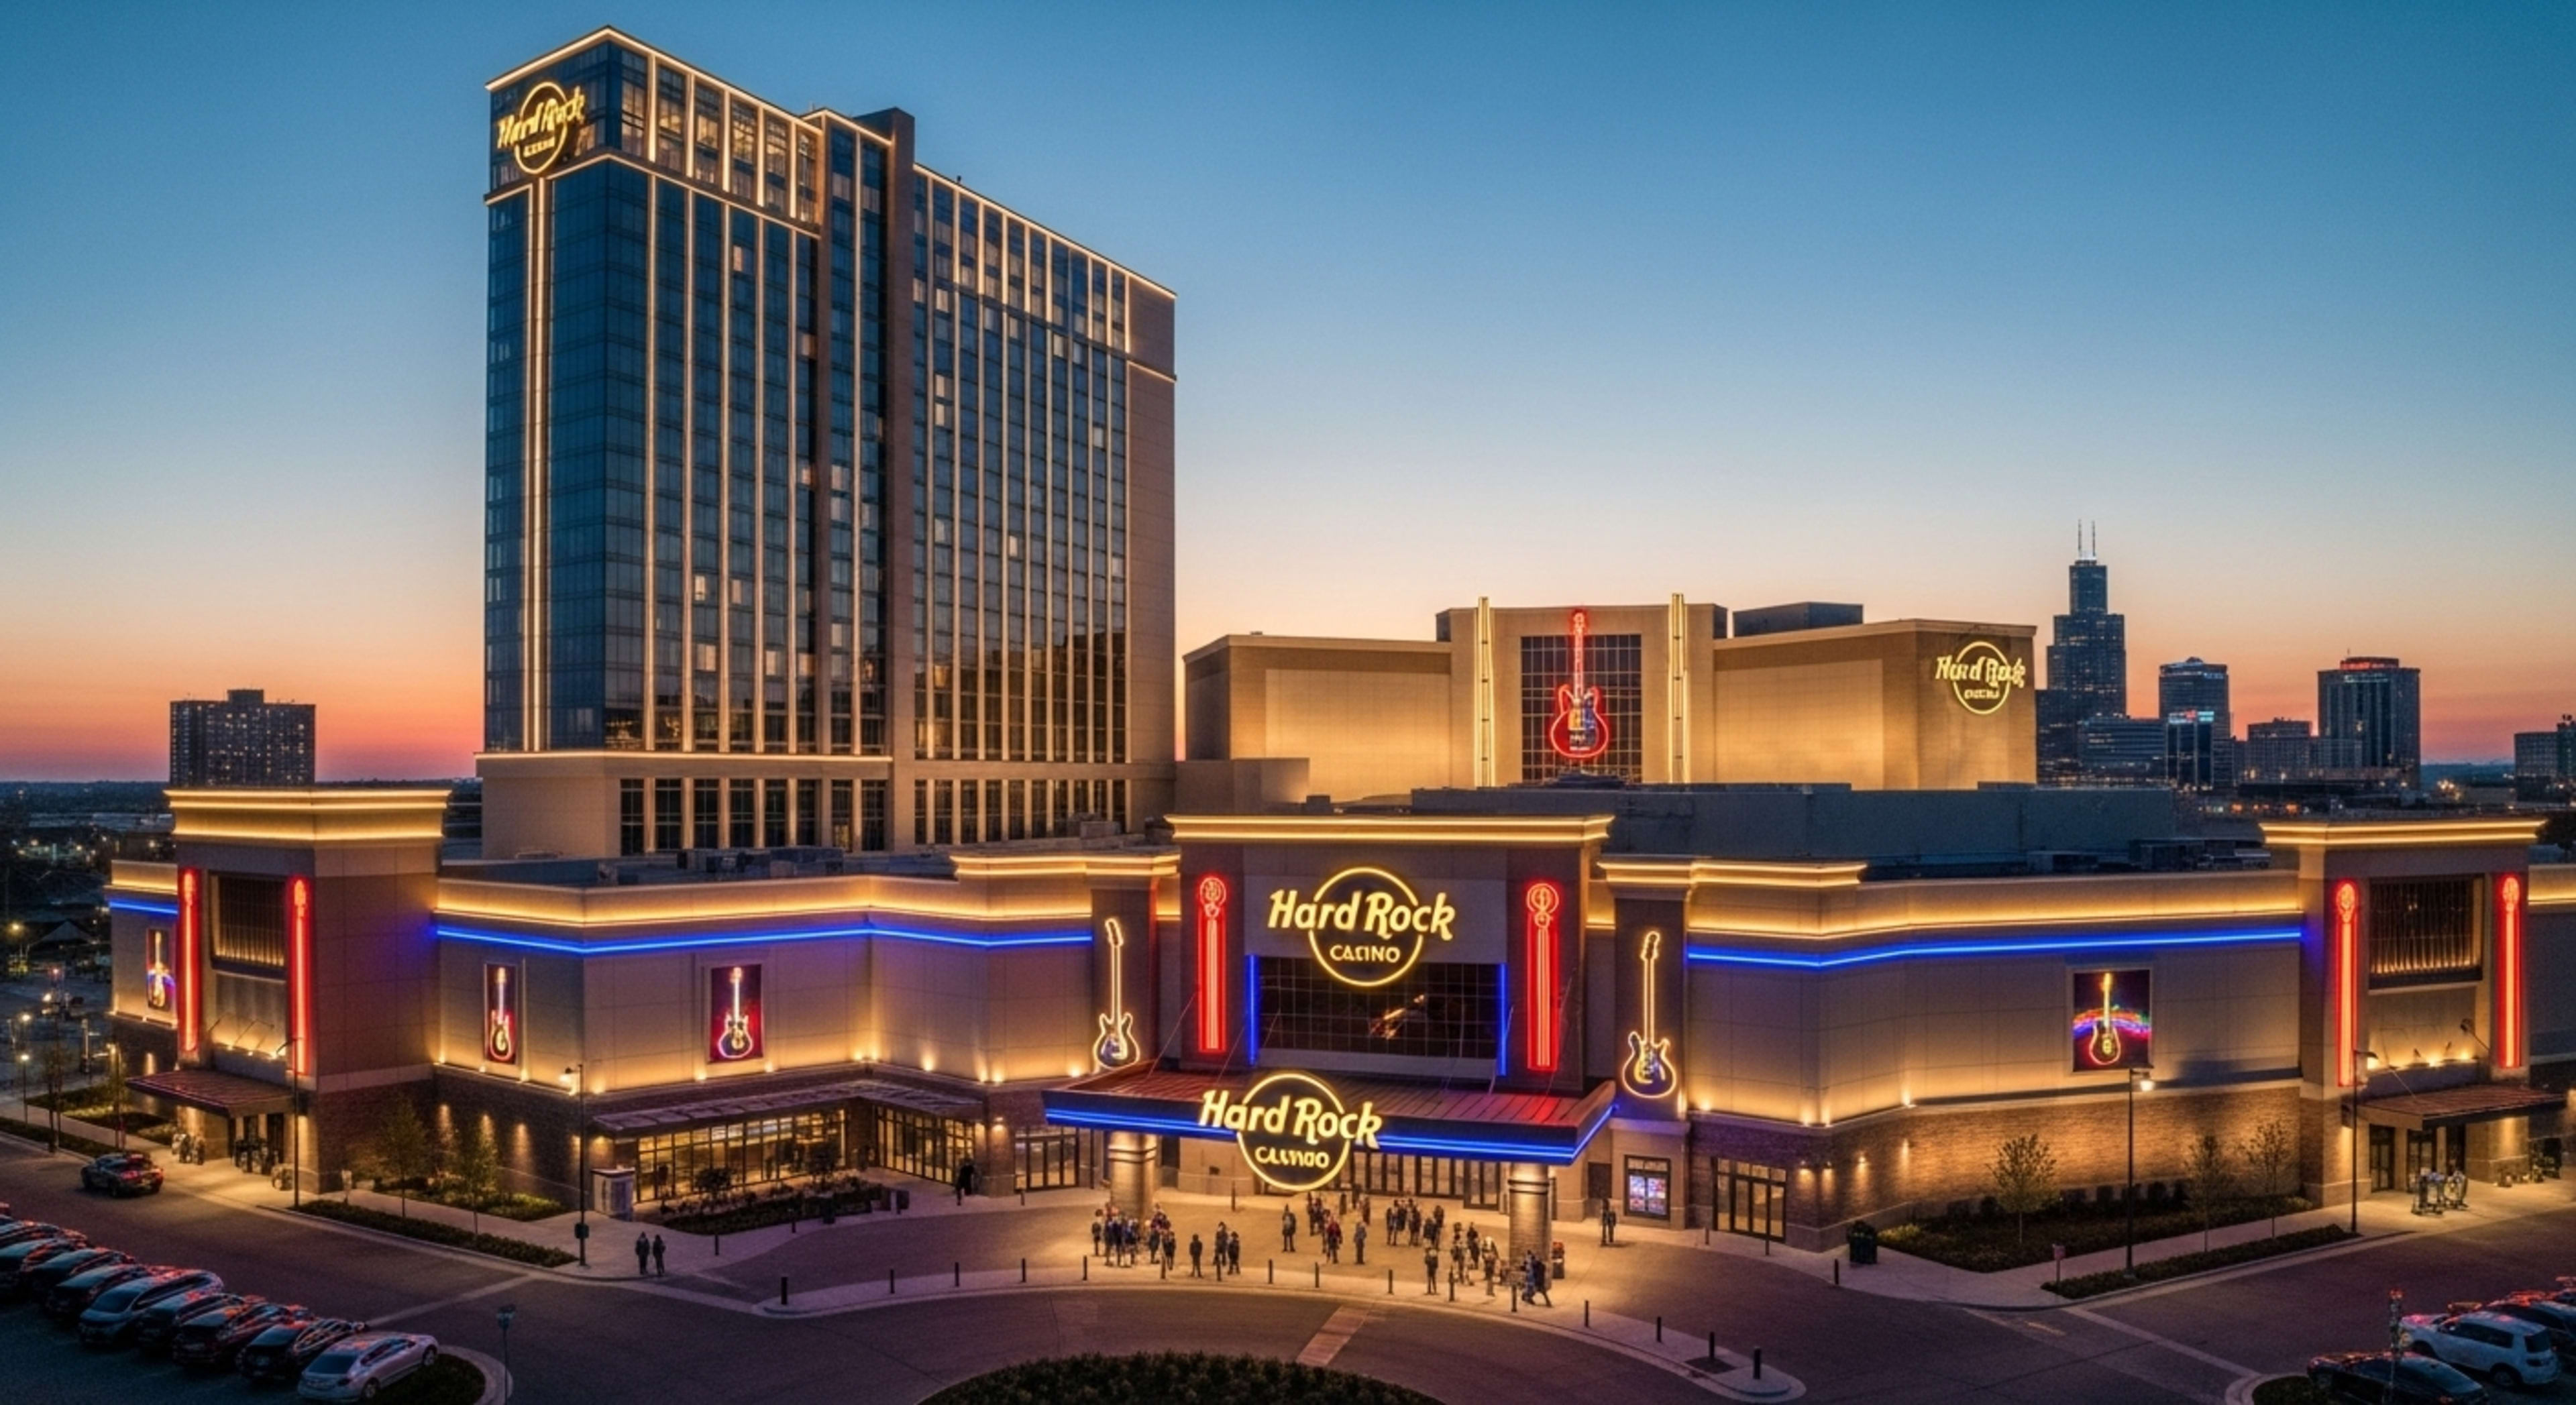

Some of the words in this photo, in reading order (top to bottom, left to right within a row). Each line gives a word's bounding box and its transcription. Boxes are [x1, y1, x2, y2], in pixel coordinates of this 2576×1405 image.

[1269, 890, 1360, 930] Hard
[1364, 892, 1455, 940] Rock
[1199, 1090, 1289, 1133] Hard
[1293, 1097, 1382, 1149] Rock
